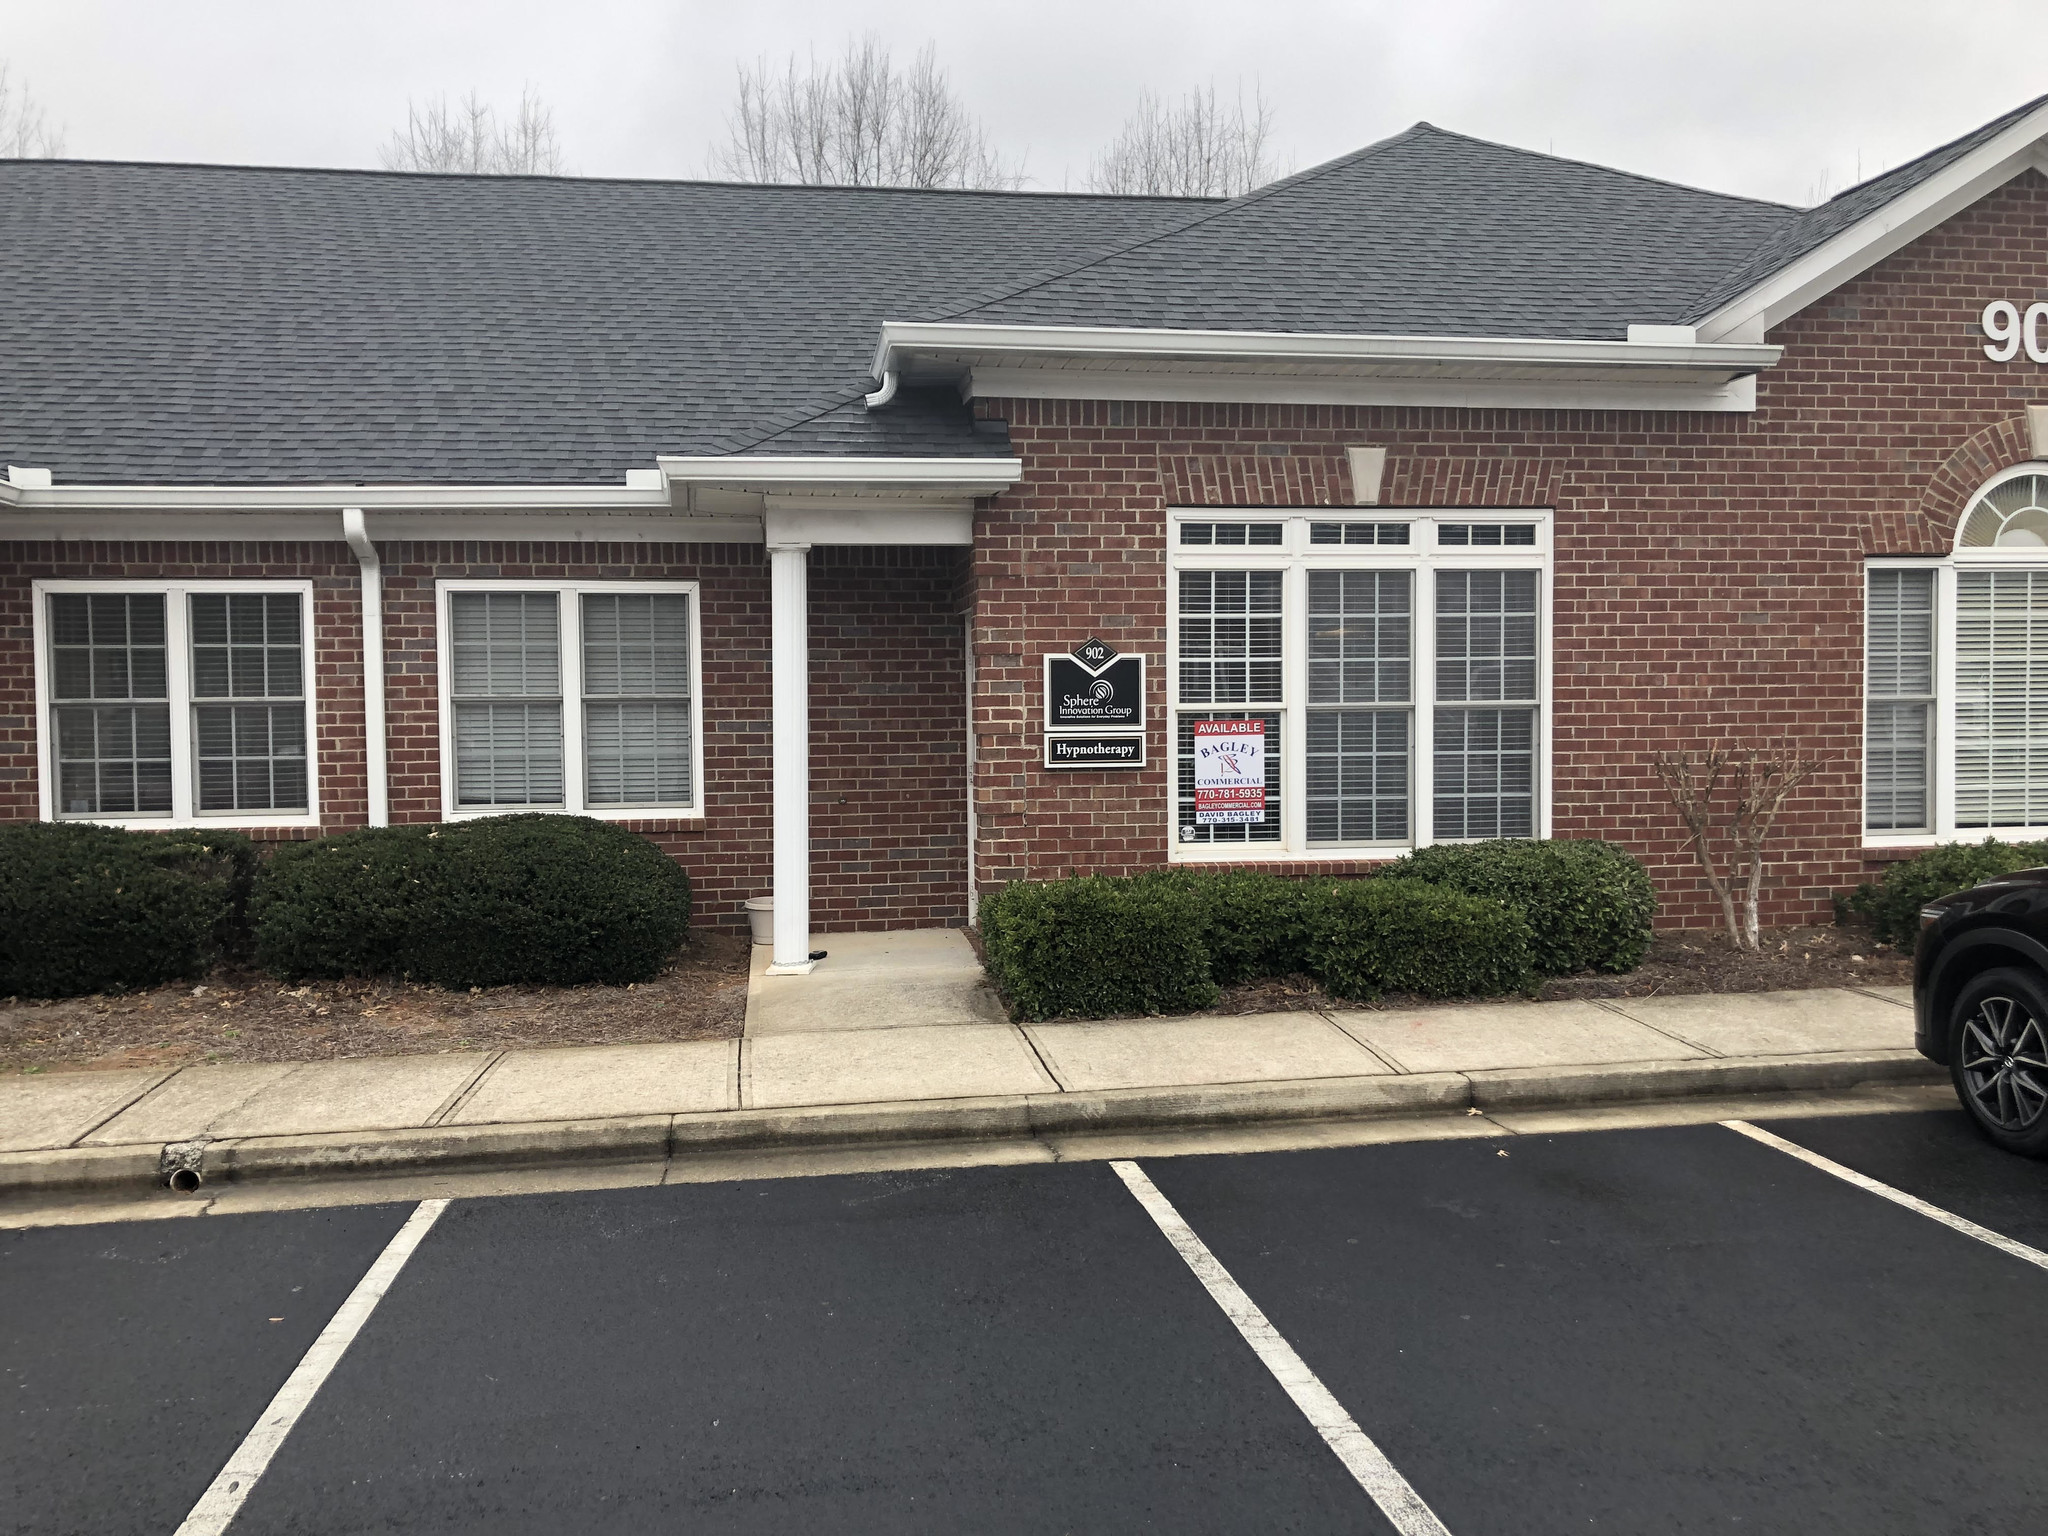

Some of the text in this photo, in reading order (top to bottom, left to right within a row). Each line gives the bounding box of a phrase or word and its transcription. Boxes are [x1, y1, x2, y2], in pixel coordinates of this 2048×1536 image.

[1981, 300, 2048, 364] 90
[1085, 646, 1105, 660] 902
[1063, 693, 1100, 709] Sphere
[1059, 705, 1132, 717] Innovation Group
[1198, 722, 1261, 734] AVAILABLE
[1056, 742, 1135, 758] Hypnotherapy
[1200, 741, 1260, 759] BAGLEY
[1197, 777, 1262, 786] COMMERCIAL
[1197, 788, 1263, 799] 770-781-5935
[1198, 801, 1262, 810] BAGLEYCOMMERCIAL.COM
